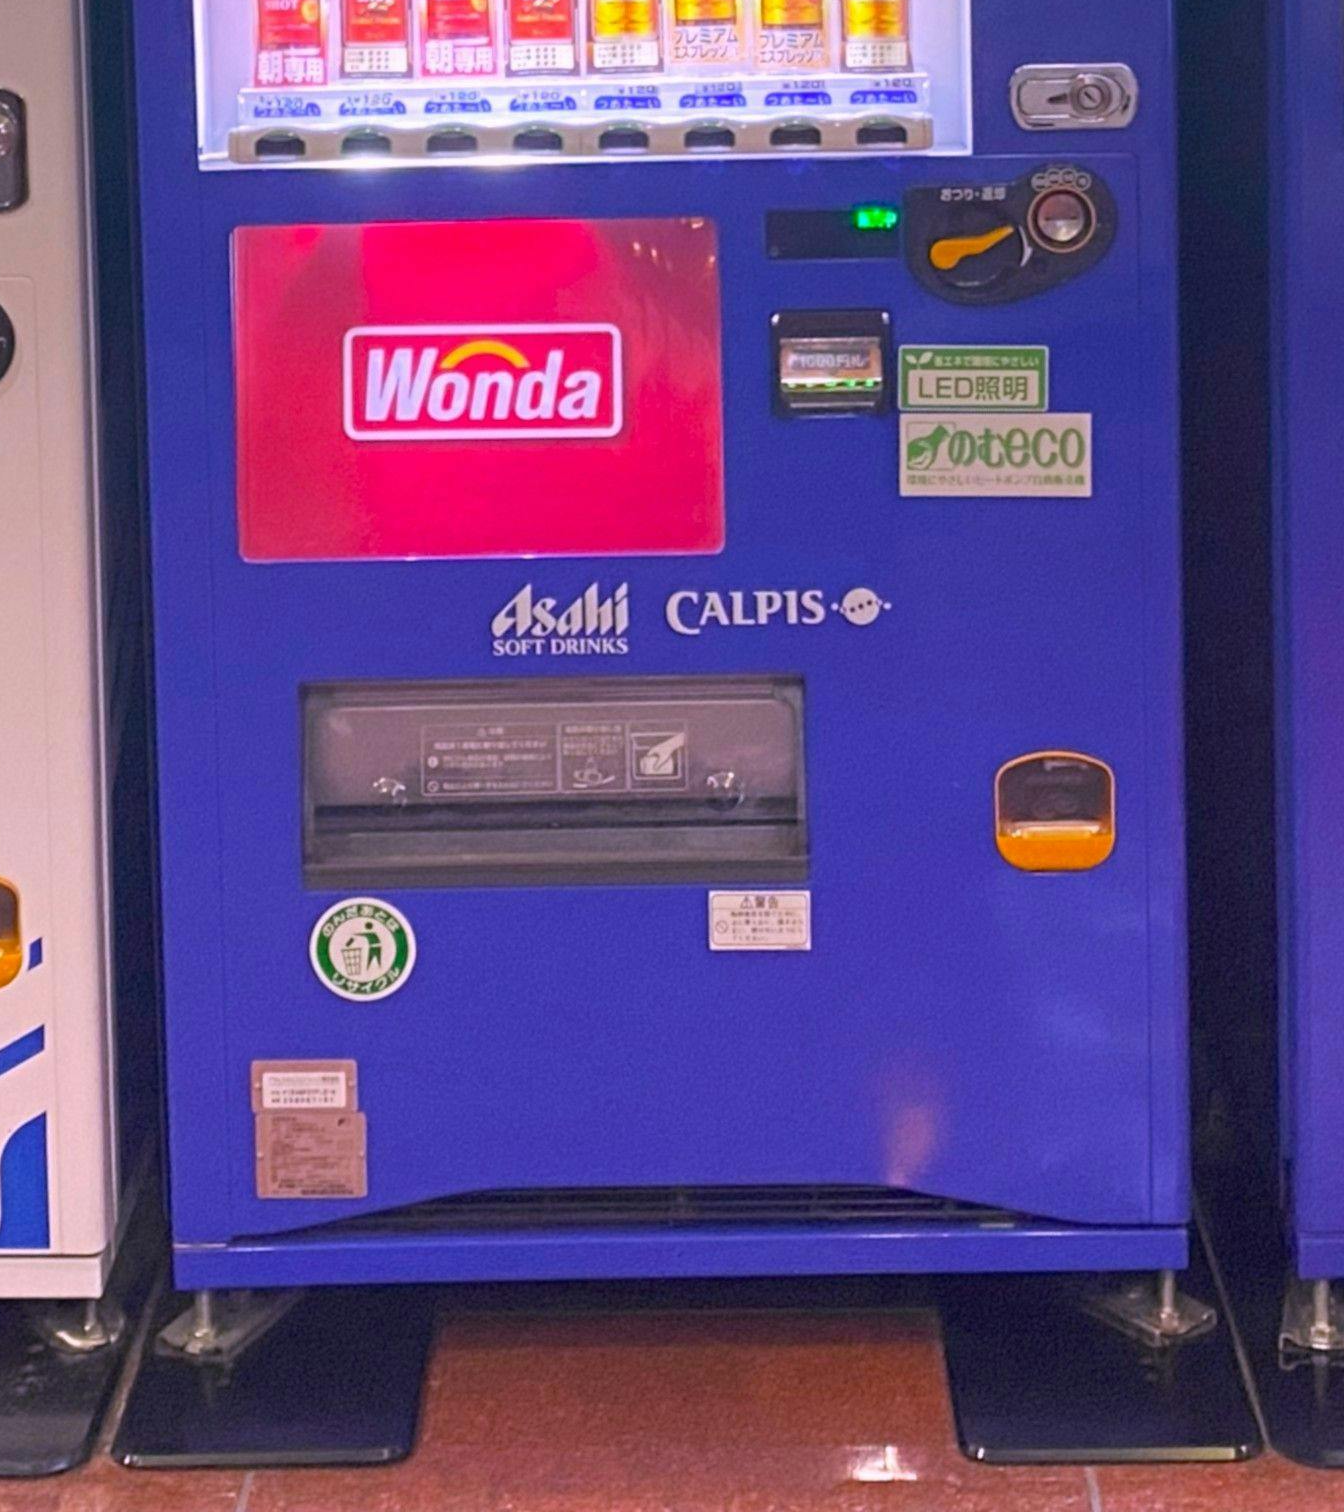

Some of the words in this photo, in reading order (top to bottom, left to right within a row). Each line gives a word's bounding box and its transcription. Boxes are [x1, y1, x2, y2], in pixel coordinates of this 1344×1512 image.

[674, 28, 738, 45] プレミアム
[760, 34, 824, 49] プレミアム
[363, 347, 602, 423] Wonda
[917, 375, 1030, 401] LED照明
[947, 427, 1086, 469] のむeco
[490, 581, 630, 638] Asahi
[665, 589, 826, 635] CALPIS
[492, 638, 547, 656] SOFT
[550, 637, 629, 656] DRINKS
